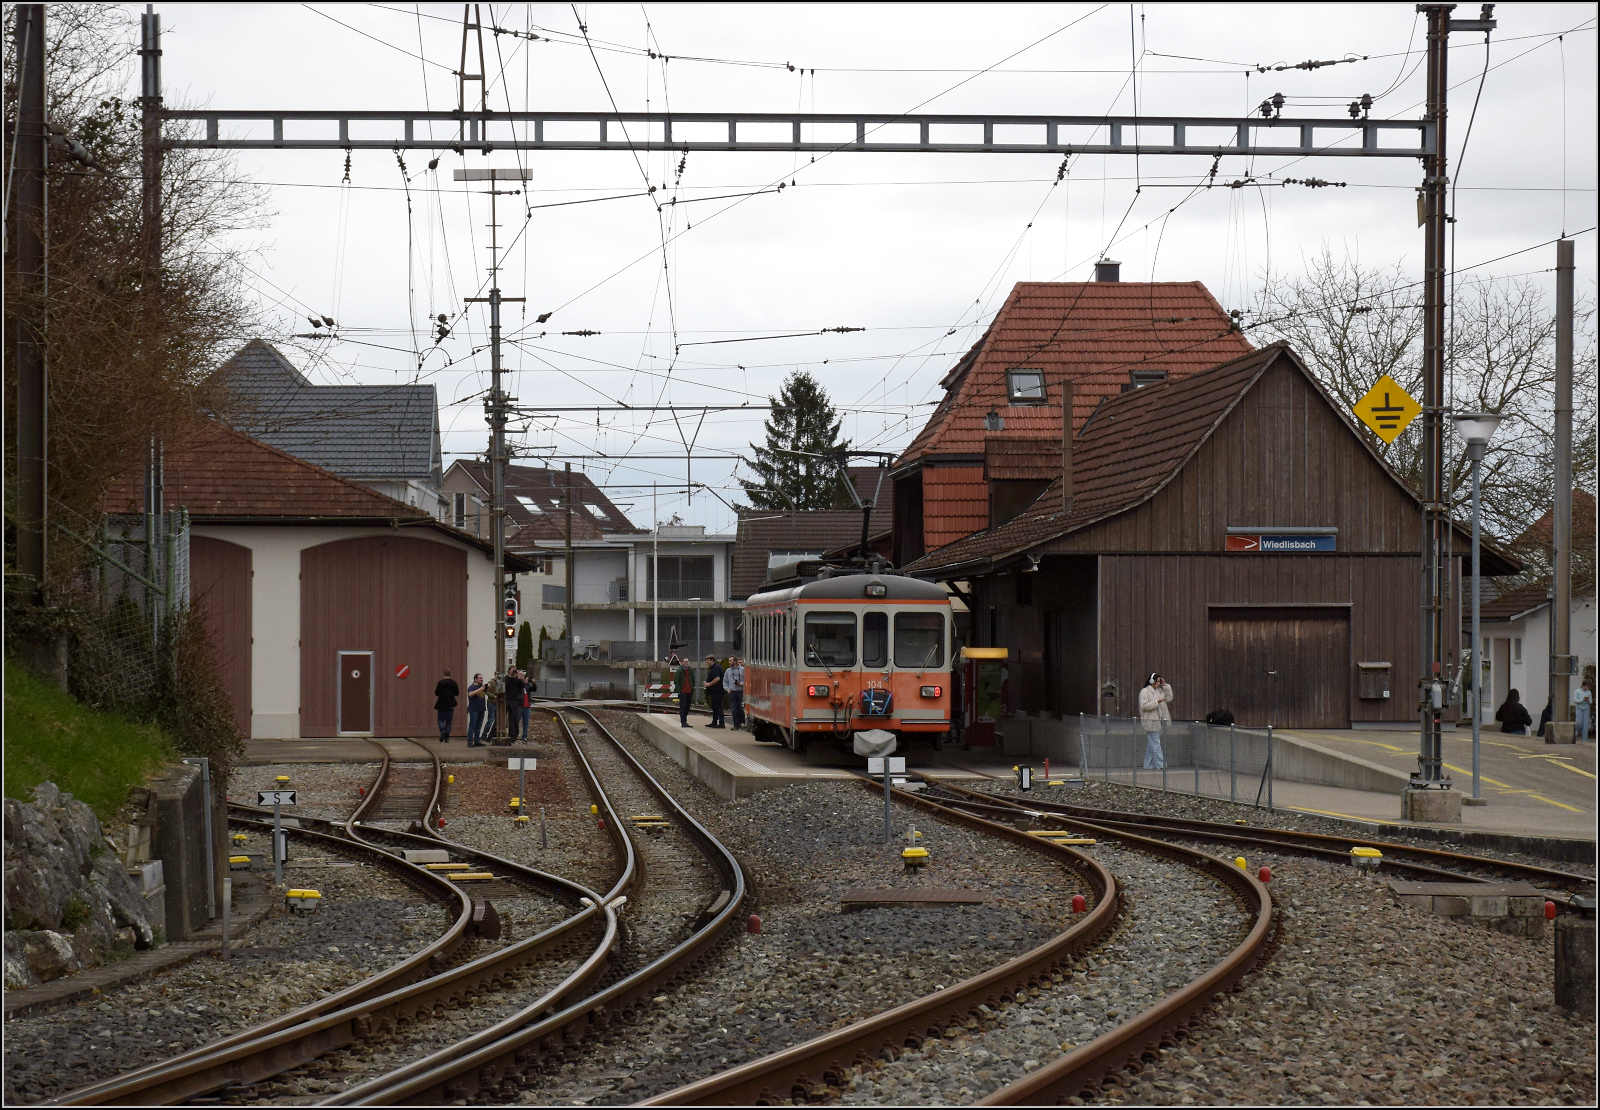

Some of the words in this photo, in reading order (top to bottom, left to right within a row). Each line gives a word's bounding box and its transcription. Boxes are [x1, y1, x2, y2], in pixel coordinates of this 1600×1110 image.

[1263, 540, 1316, 549] Wiedlisbach
[867, 680, 882, 689] 104
[273, 792, 281, 805] S
